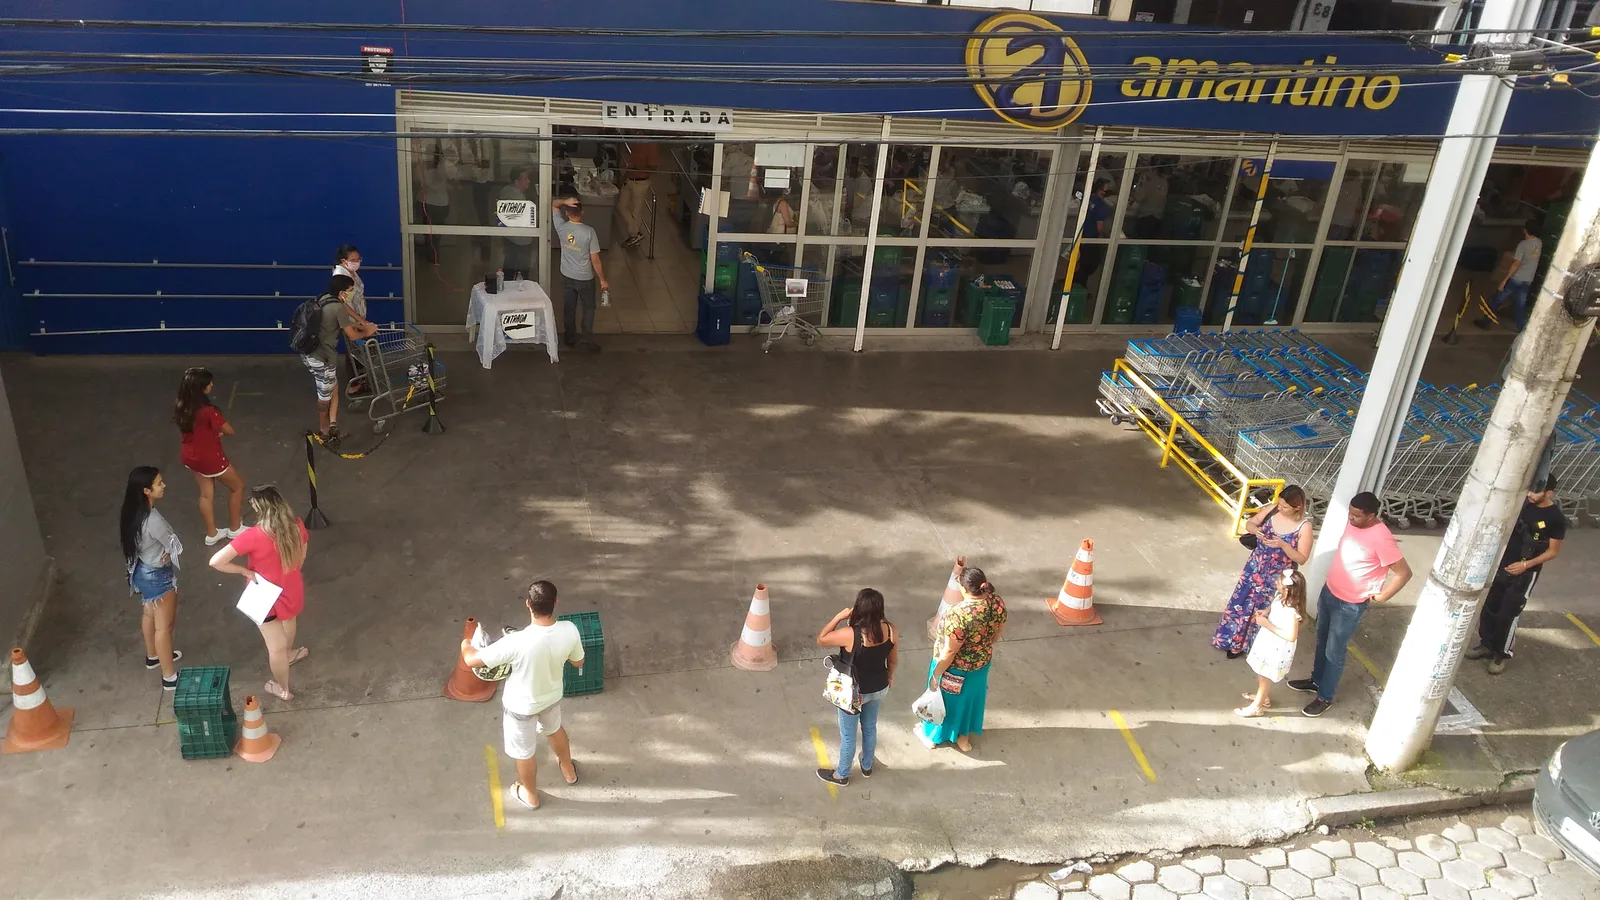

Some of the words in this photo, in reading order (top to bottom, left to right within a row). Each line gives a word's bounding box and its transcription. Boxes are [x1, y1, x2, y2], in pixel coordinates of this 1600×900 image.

[1121, 55, 1400, 110] amantino
[606, 104, 731, 125] ENTRADA
[499, 202, 527, 214] ENTRADA
[503, 314, 528, 324] ENTRADA
